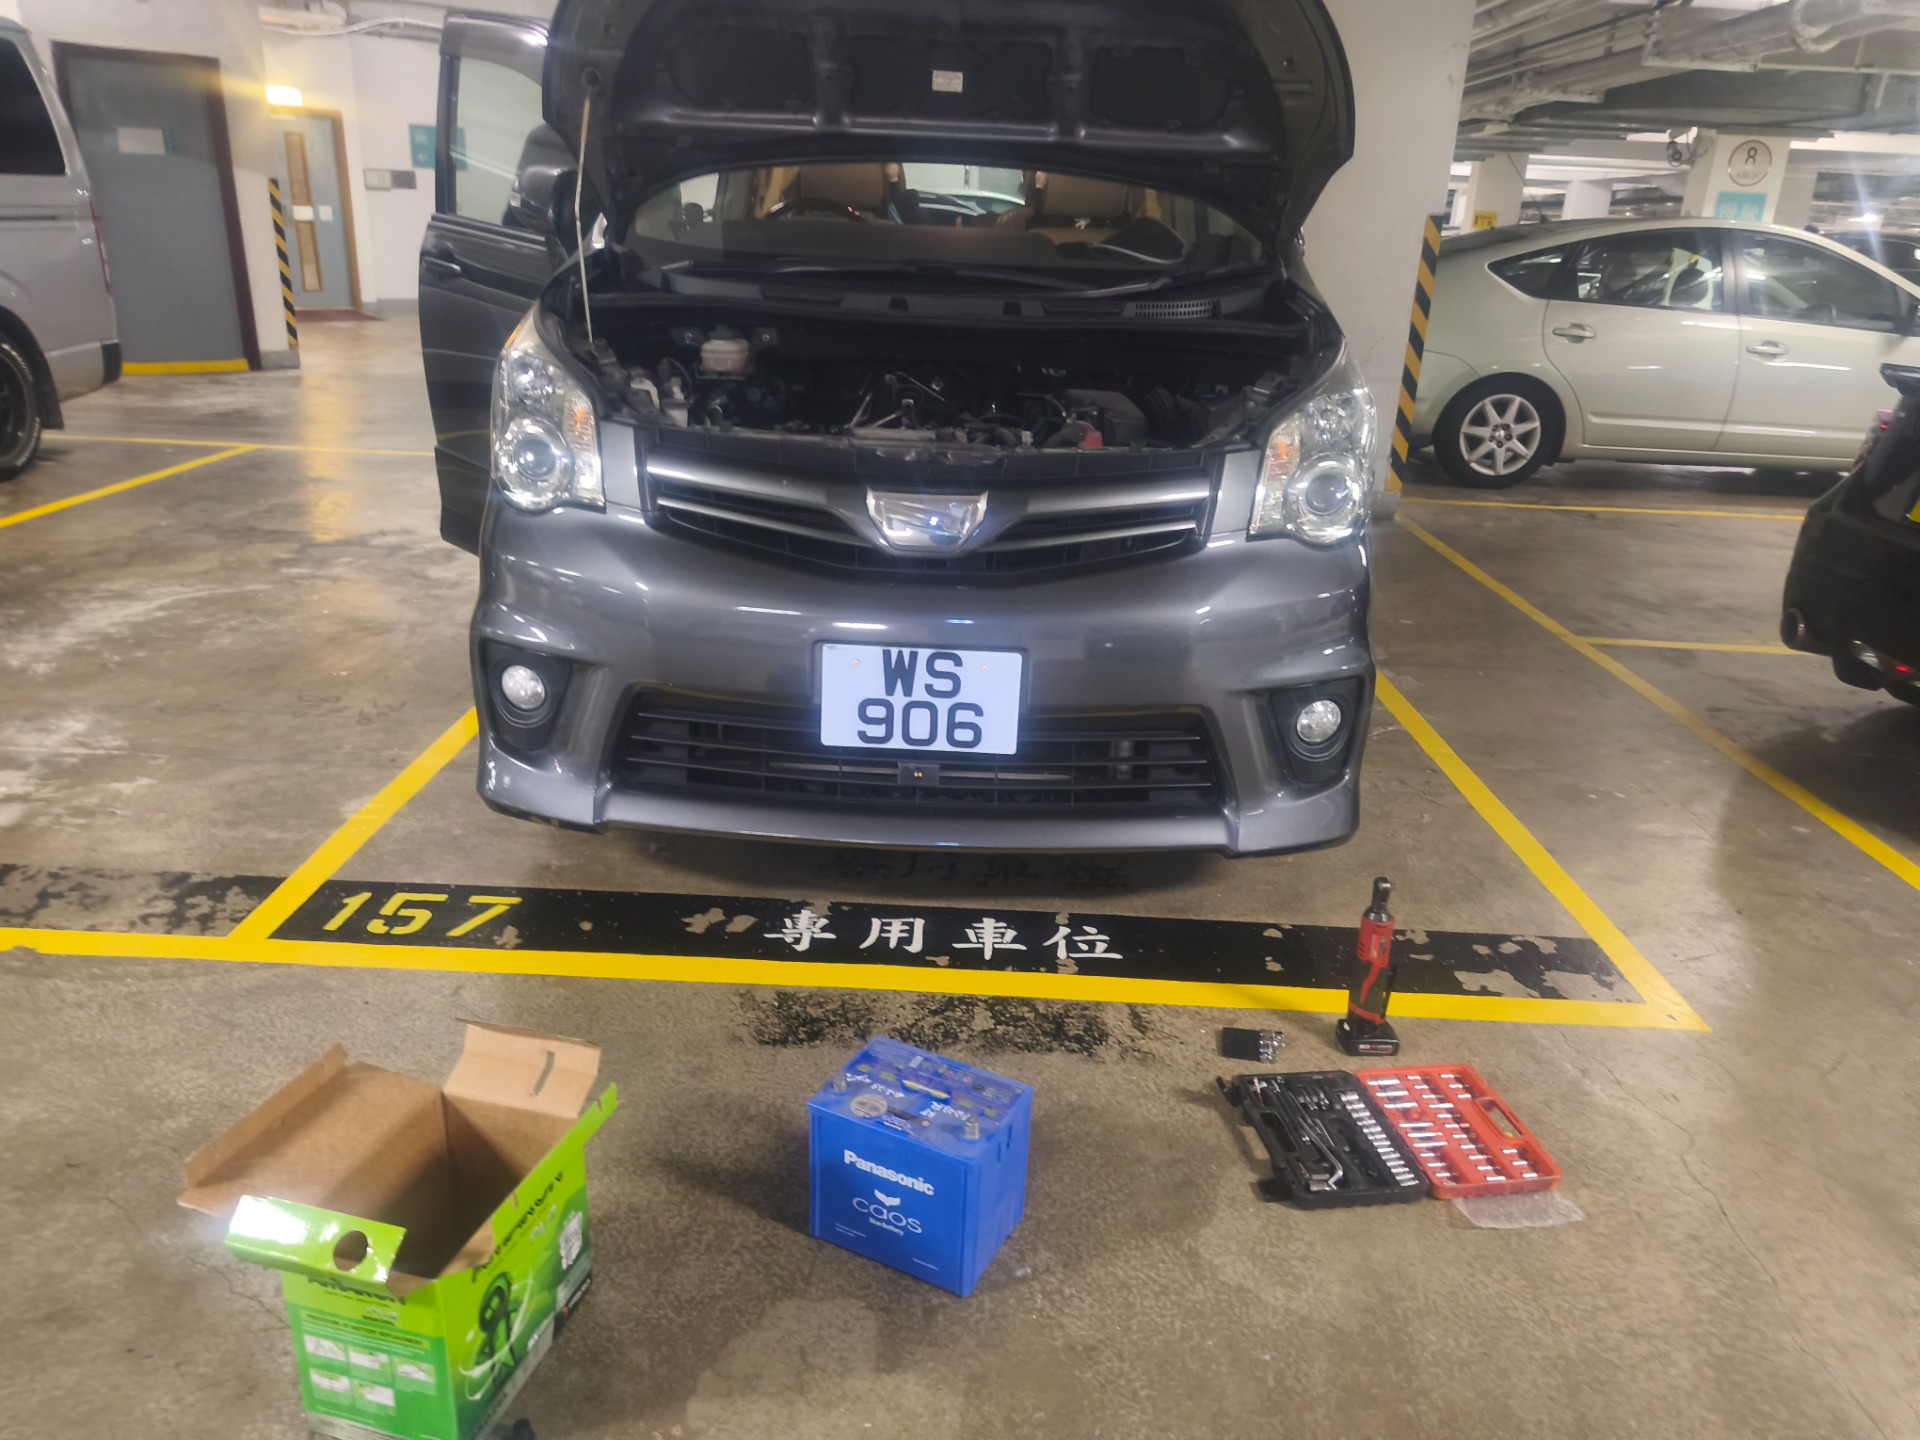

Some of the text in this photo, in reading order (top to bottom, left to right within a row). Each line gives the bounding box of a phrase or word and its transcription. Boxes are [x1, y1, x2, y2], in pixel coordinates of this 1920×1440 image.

[882, 648, 963, 698] WS
[857, 698, 984, 749] 906
[323, 892, 522, 937] 157
[763, 909, 1123, 960] 專用車位
[844, 1149, 934, 1196] Panasonic
[852, 1198, 922, 1233] caos
